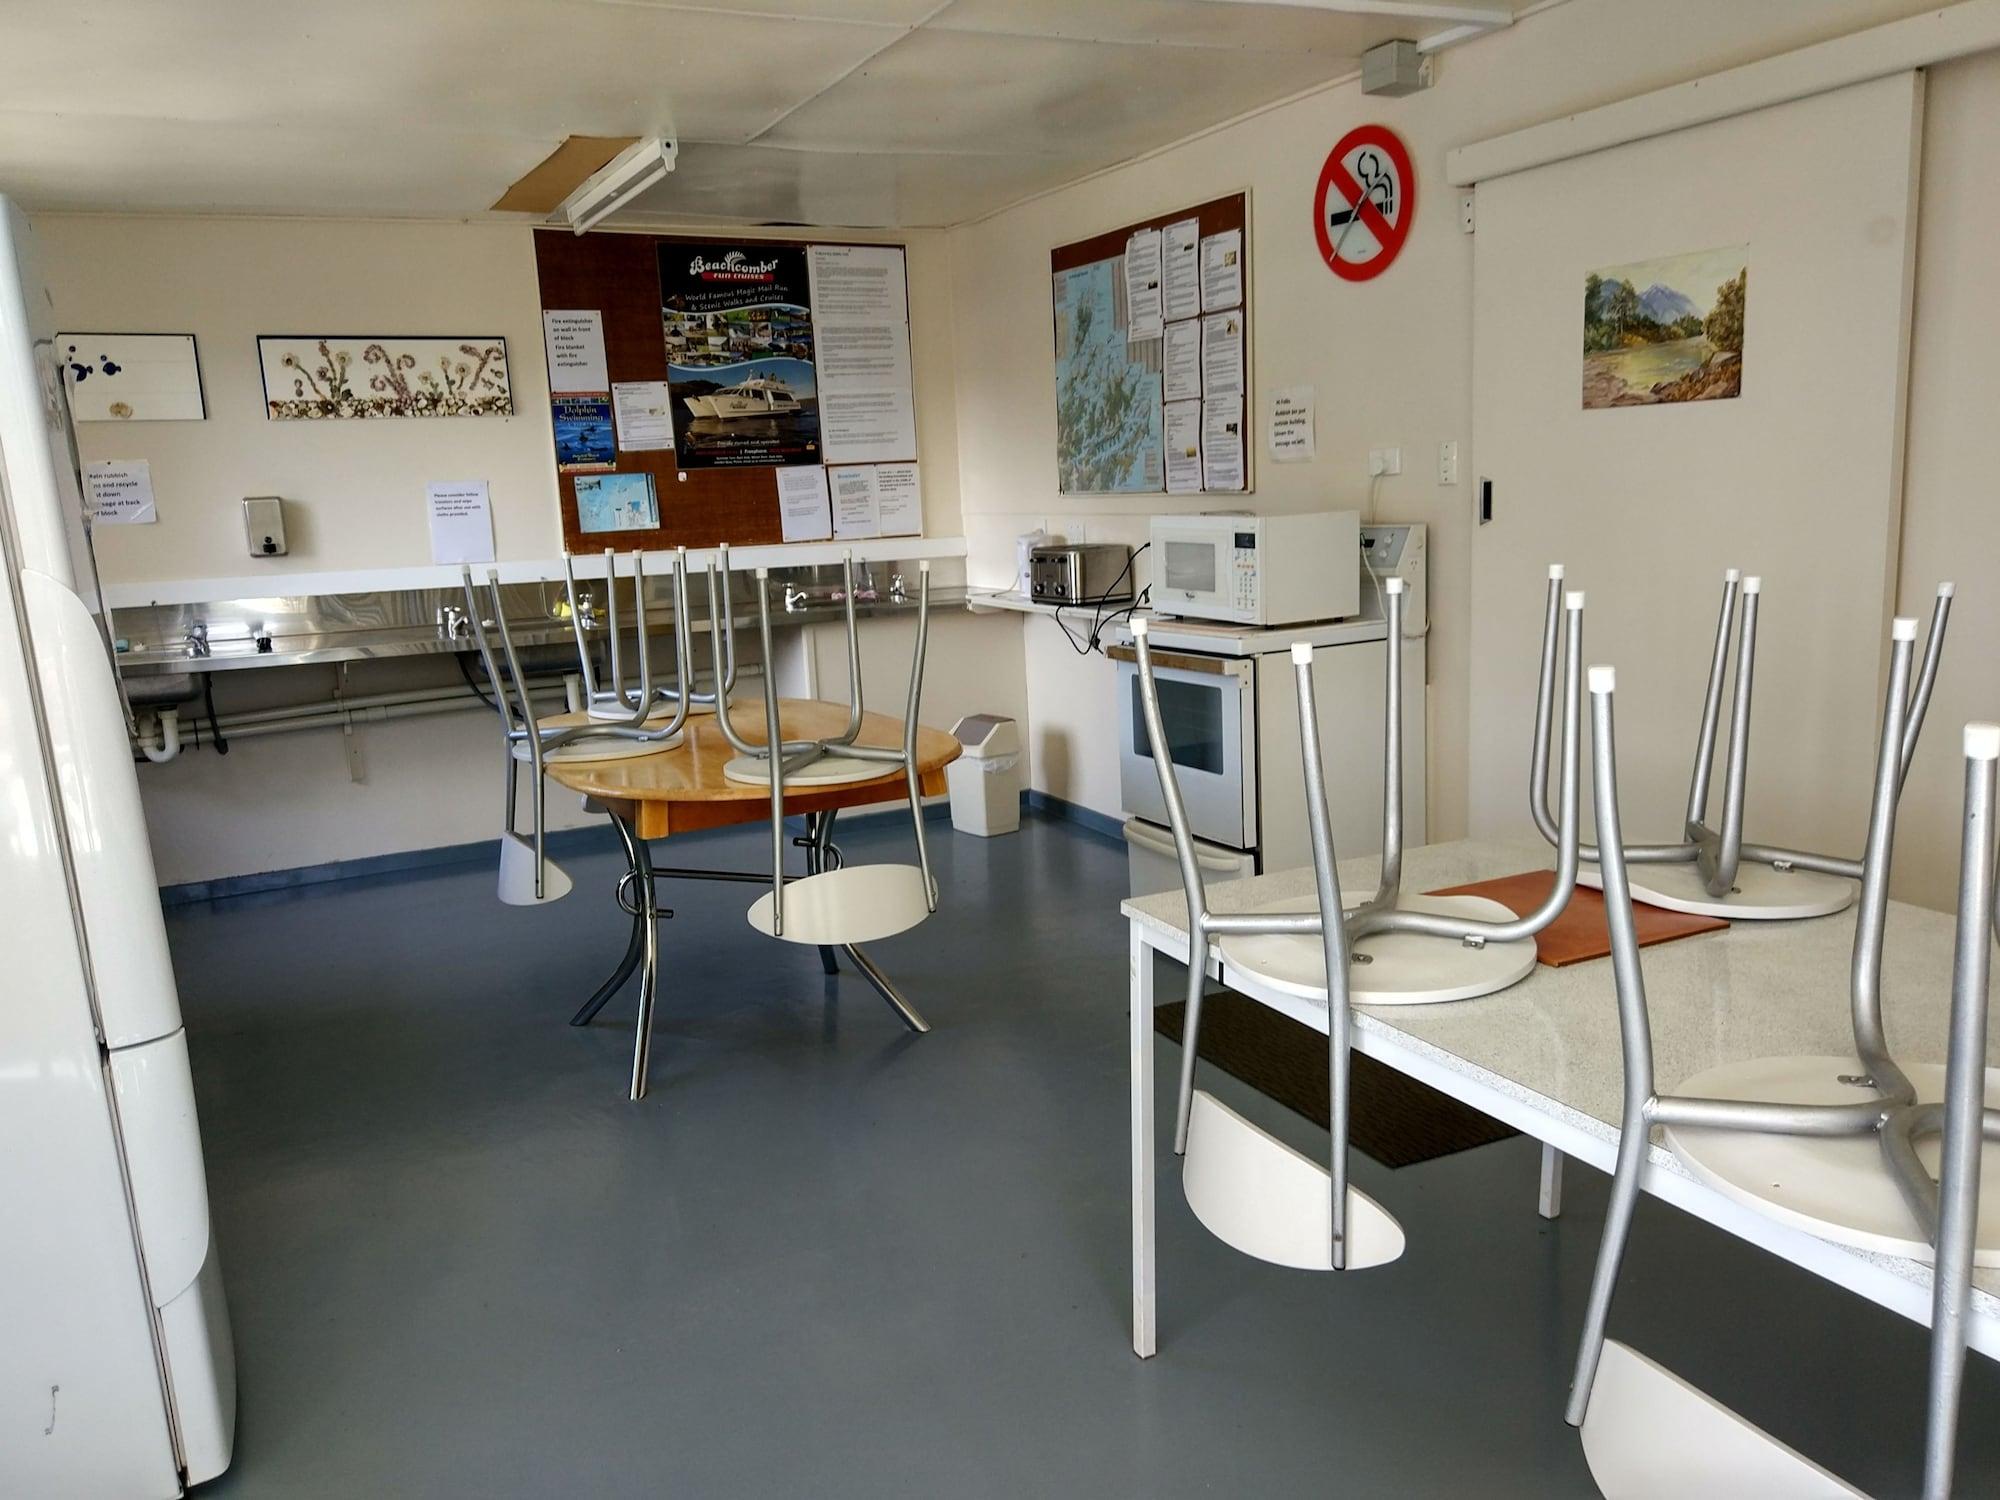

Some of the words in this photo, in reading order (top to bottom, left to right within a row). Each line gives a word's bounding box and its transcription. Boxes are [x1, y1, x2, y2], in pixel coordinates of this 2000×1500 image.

[689, 255, 779, 275] Beachcomber
[685, 292, 706, 301] World
[708, 290, 735, 299] Famous
[736, 287, 755, 297] Magic
[758, 284, 772, 293] Mail
[774, 283, 788, 292] Run
[699, 301, 721, 311] Scenic
[723, 298, 743, 308] Walks
[760, 294, 784, 302] Cruises
[559, 413, 604, 422] Swimming
[564, 404, 597, 416] Dolphin
